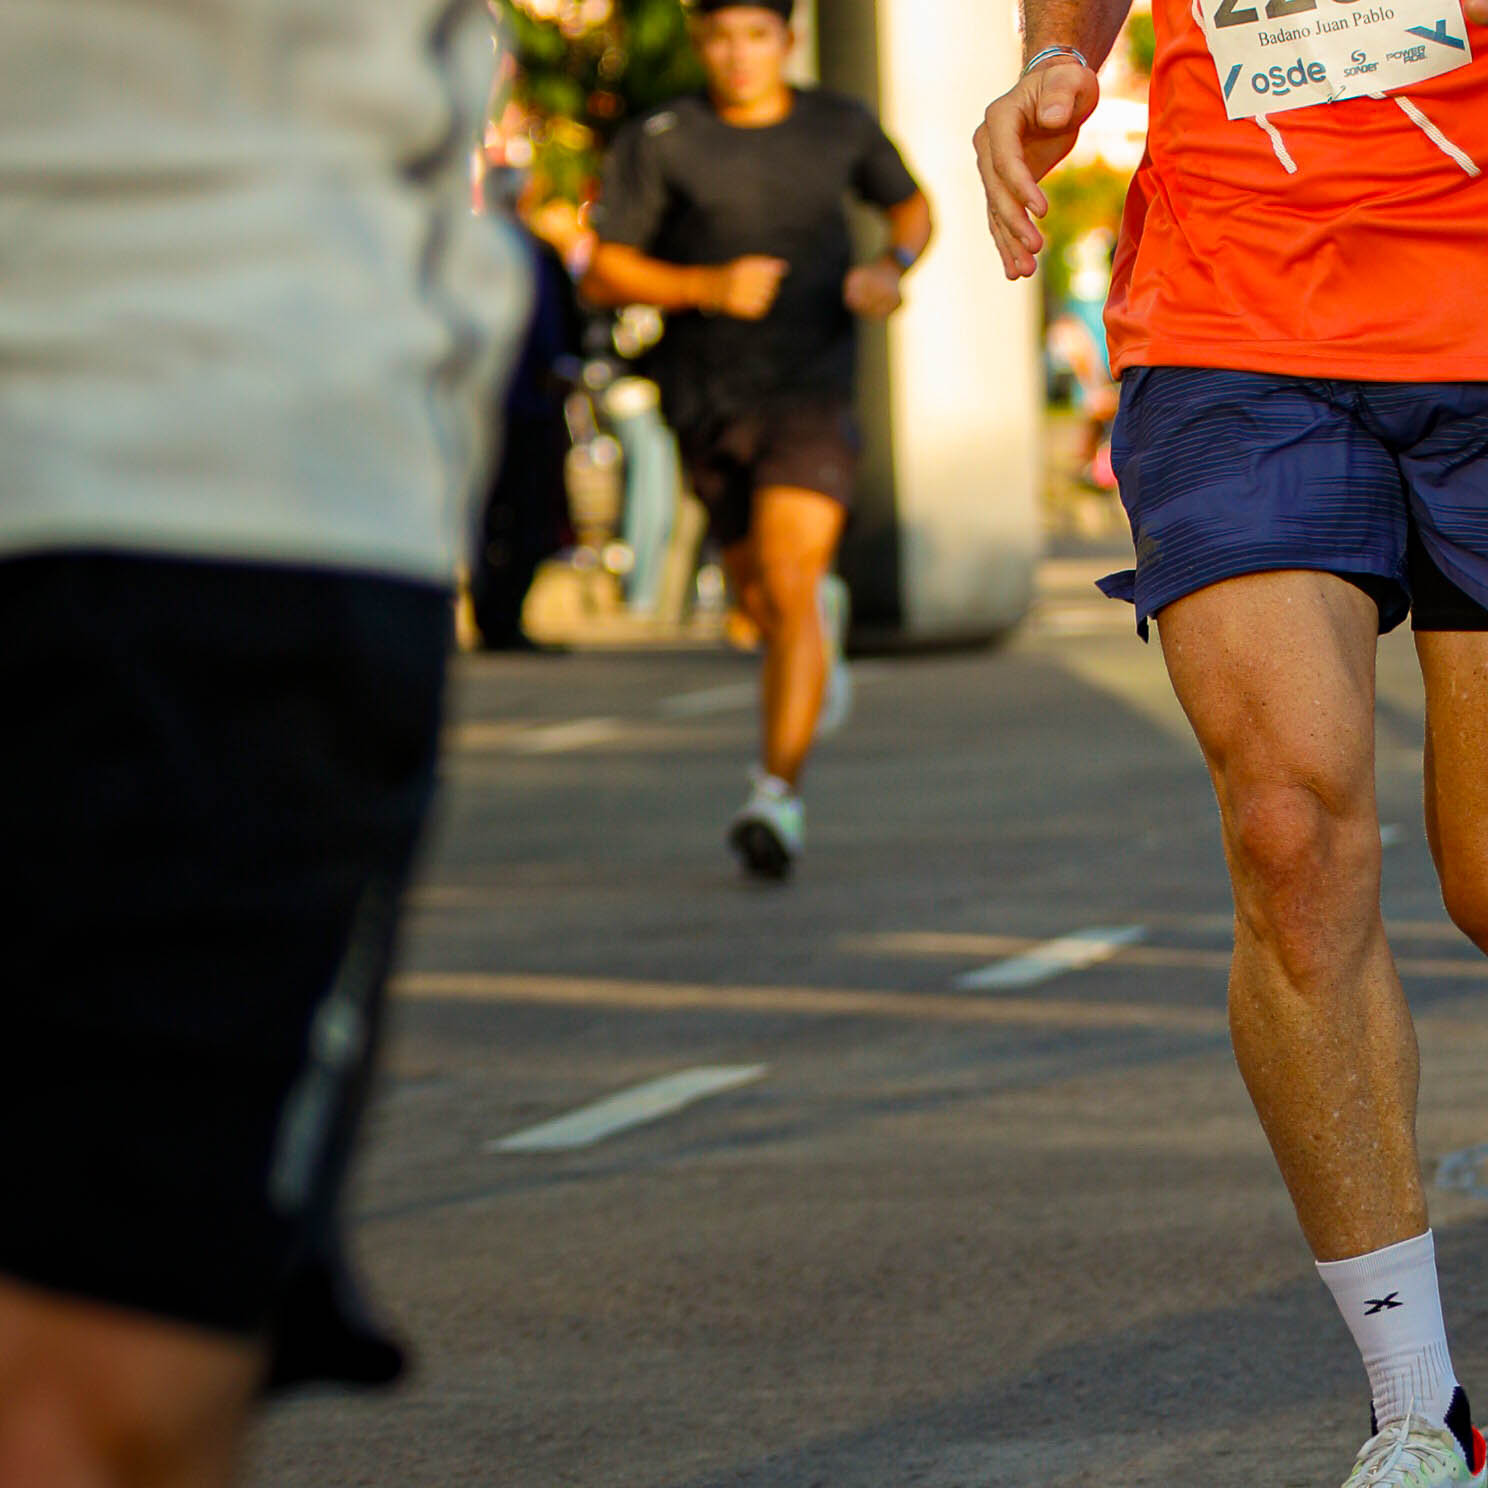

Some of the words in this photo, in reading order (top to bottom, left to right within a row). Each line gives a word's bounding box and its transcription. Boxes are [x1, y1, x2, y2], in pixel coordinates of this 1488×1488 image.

[1258, 27, 1312, 47] Badano
[1315, 18, 1349, 36] Juan
[1352, 6, 1395, 27] Pablo
[1251, 56, 1327, 96] osde
